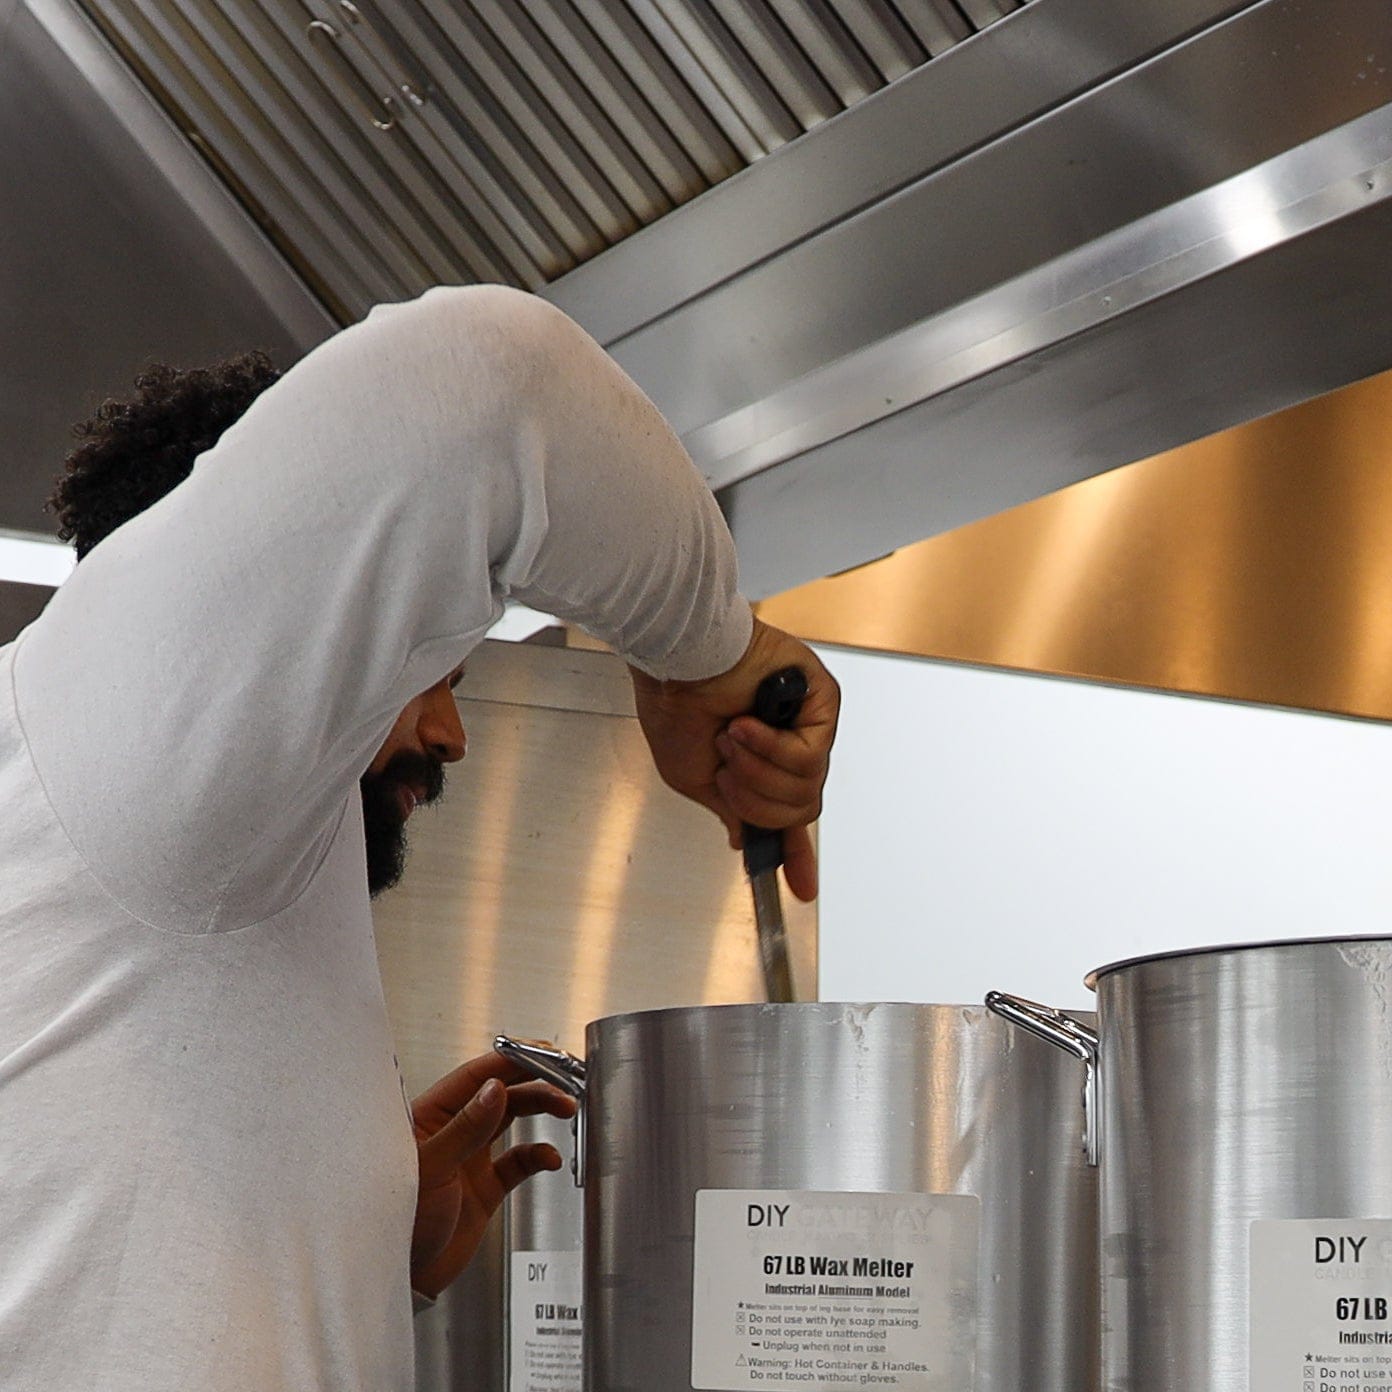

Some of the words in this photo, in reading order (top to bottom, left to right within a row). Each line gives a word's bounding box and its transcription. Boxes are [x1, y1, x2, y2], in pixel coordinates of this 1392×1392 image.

[747, 1204, 790, 1227] DIY
[1314, 1236, 1367, 1263] DIY
[527, 1263, 547, 1281] DIY
[762, 1254, 783, 1275] 67
[785, 1255, 806, 1275] LB
[809, 1255, 848, 1276] Wax
[852, 1257, 914, 1278] Melter
[764, 1282, 816, 1295] Industrial
[817, 1284, 874, 1296] Aluminum
[874, 1285, 910, 1298] Model
[1335, 1297, 1359, 1320] 67
[1364, 1297, 1387, 1320] LB
[748, 1312, 764, 1323] Do
[764, 1313, 782, 1324] not
[783, 1315, 803, 1324] use
[804, 1315, 828, 1324] with
[829, 1315, 846, 1327] lye
[848, 1317, 876, 1328] soap
[748, 1325, 763, 1336] Do
[764, 1327, 782, 1336] not
[782, 1327, 823, 1339] operate
[825, 1328, 887, 1339] unattended
[762, 1339, 800, 1353] Unplug
[801, 1341, 831, 1351] when
[832, 1342, 851, 1352] not
[852, 1344, 864, 1352] in
[865, 1344, 886, 1353] use
[794, 1358, 813, 1369] Hot
[815, 1358, 868, 1370] Container
[870, 1360, 880, 1370] &
[749, 1369, 764, 1379] Do
[765, 1370, 783, 1380] not
[784, 1370, 815, 1381] touch
[816, 1372, 857, 1382] without
[1319, 1367, 1337, 1378] Do
[1339, 1368, 1360, 1378] not
[1362, 1370, 1386, 1378] use
[1319, 1382, 1337, 1392] Do
